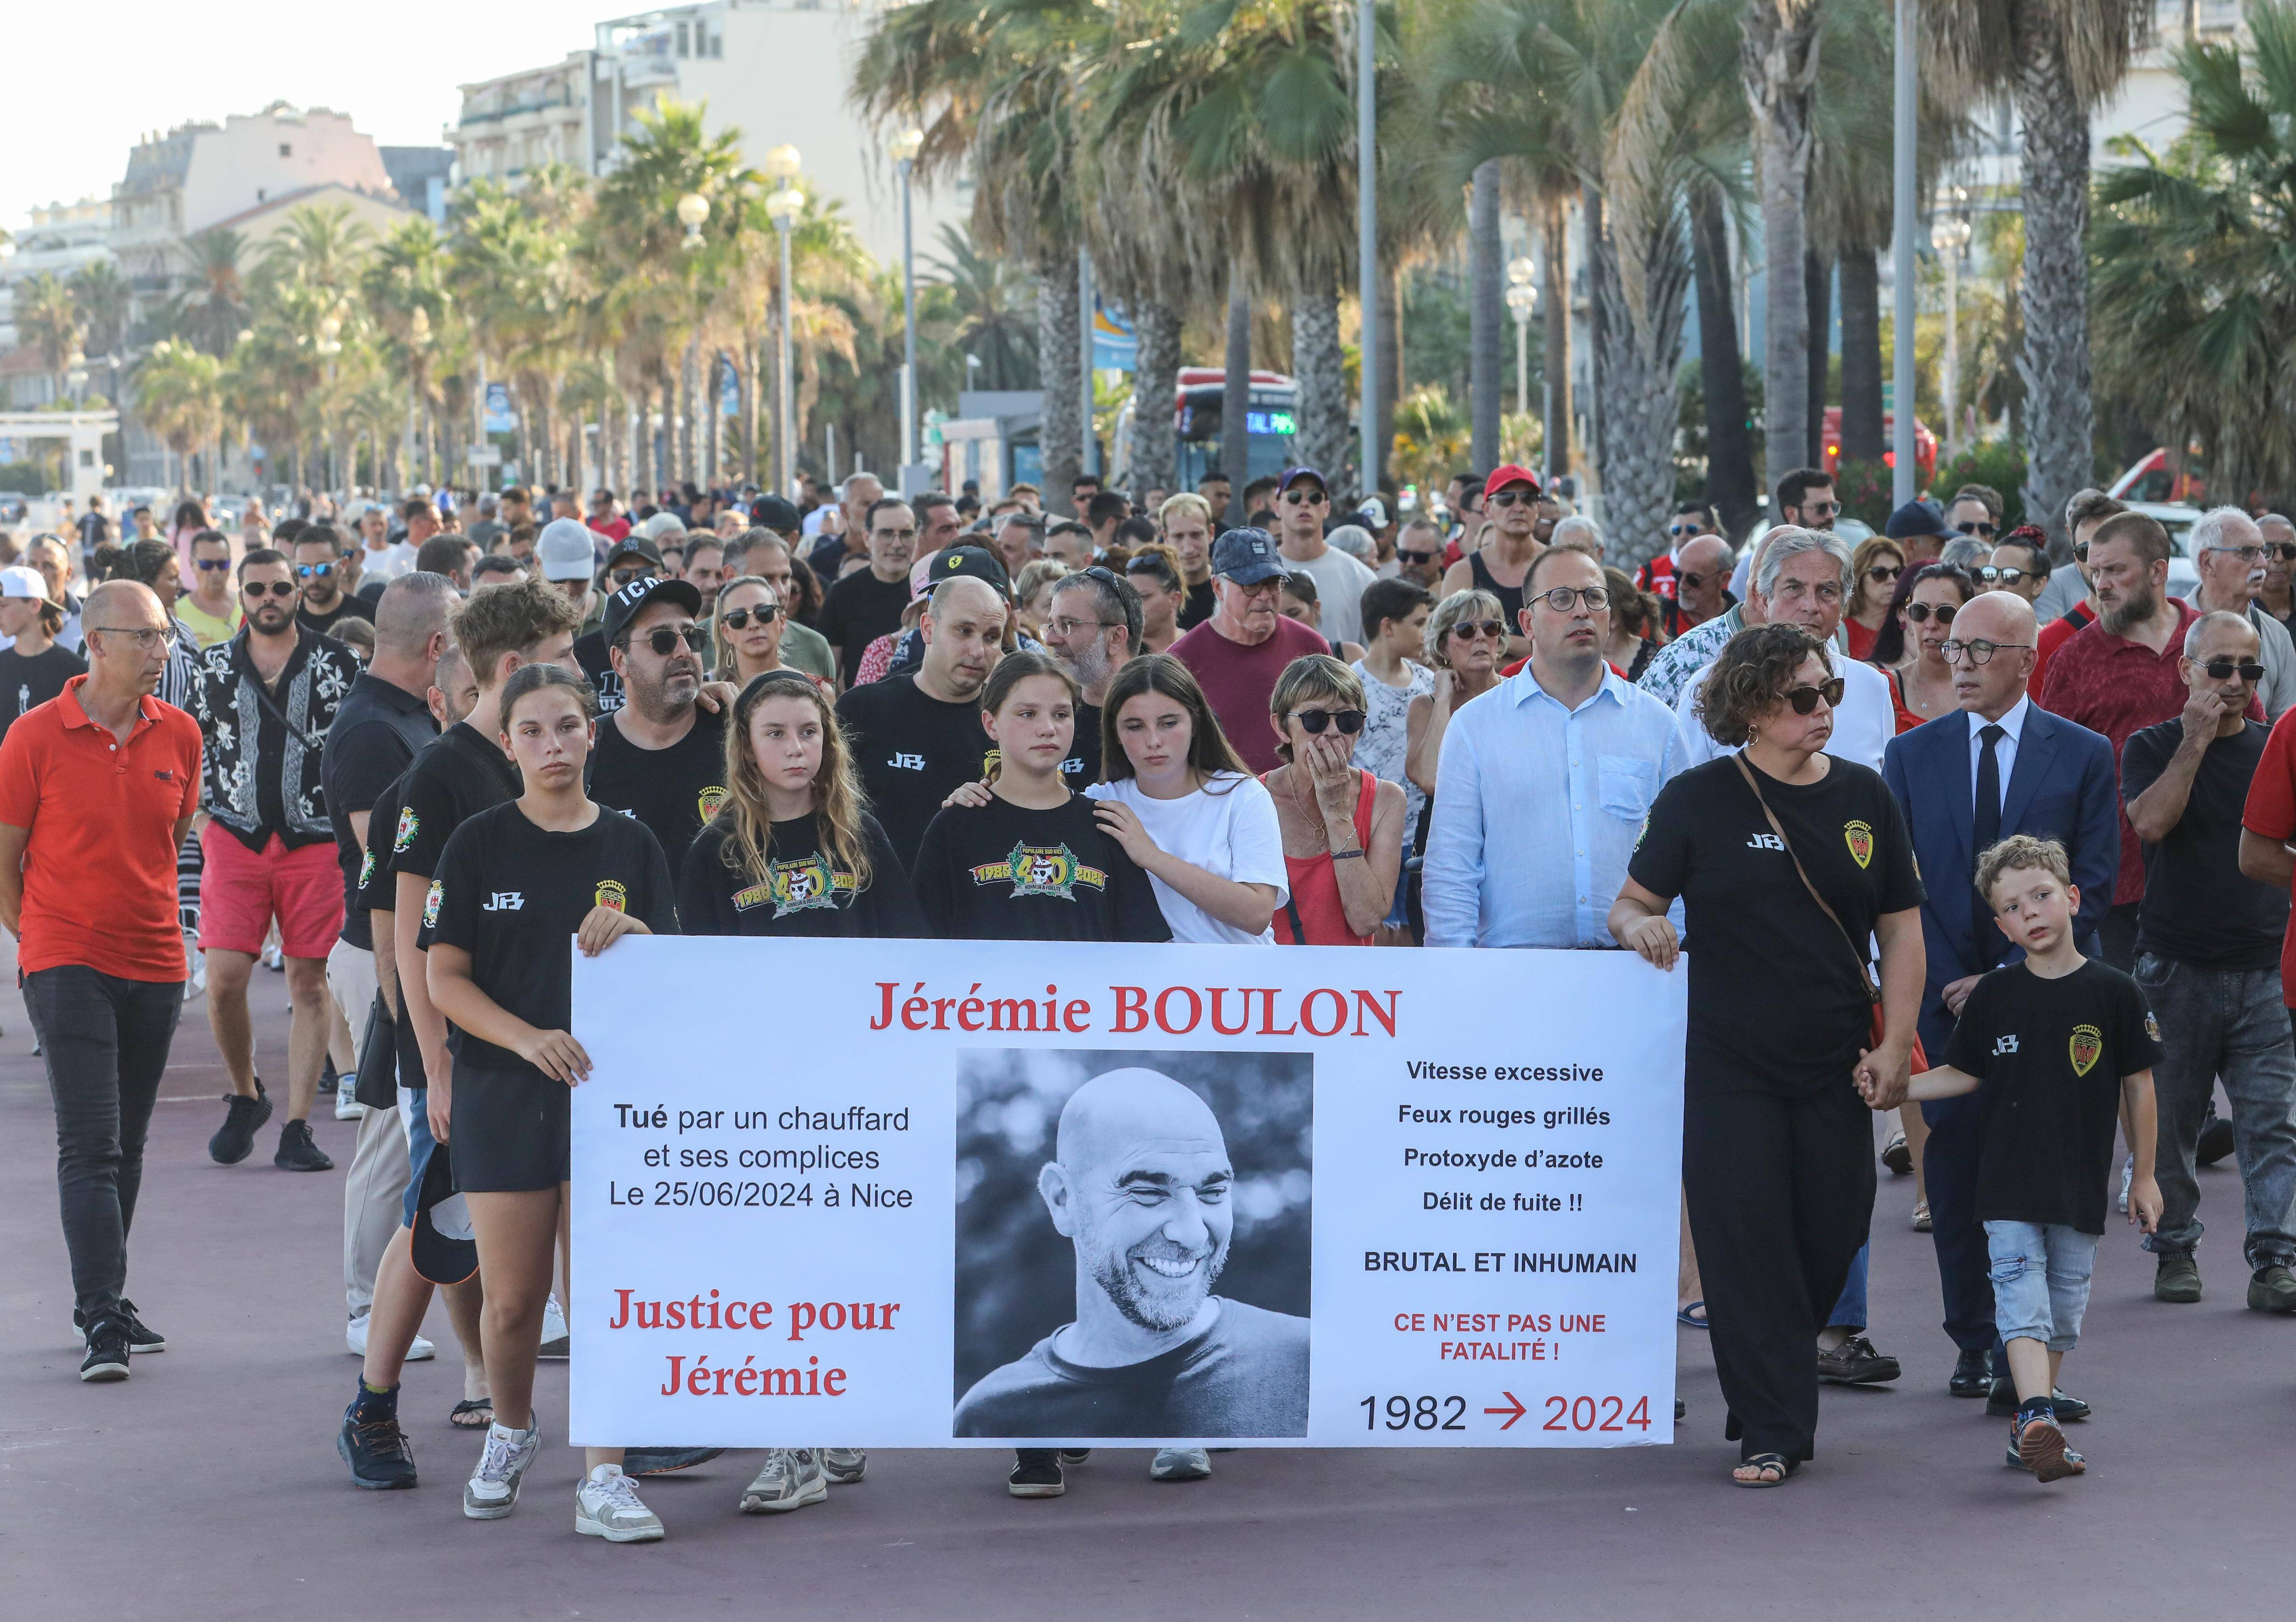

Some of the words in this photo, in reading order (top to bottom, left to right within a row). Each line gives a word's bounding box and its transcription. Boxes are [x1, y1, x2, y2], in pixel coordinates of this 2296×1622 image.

[887, 752, 926, 771] JB
[1746, 833, 1785, 852] JB
[979, 865, 1012, 881] 1985
[483, 892, 525, 911] JB
[601, 891, 622, 899] OGCN
[870, 982, 1090, 1032] Jérémie
[1109, 987, 1402, 1037] BOULON
[2076, 1036, 2098, 1045] OGCN
[1407, 1061, 1486, 1079] Vitesse
[1495, 1064, 1603, 1081] excessive
[614, 1104, 667, 1128] Tué
[680, 1111, 724, 1134] par
[735, 1112, 766, 1128] un
[779, 1106, 908, 1130] chauffard
[1400, 1105, 1451, 1122] Feux
[1460, 1110, 1535, 1128] rouges
[1544, 1107, 1610, 1128] grillés
[645, 1145, 670, 1167] et
[681, 1150, 728, 1167] ses
[740, 1145, 879, 1174] complices
[1405, 1149, 1516, 1171] Protoxyde
[1525, 1150, 1603, 1168] d’azote
[611, 1181, 643, 1205] Le
[655, 1182, 813, 1206] 25/06/2024
[825, 1184, 839, 1207] à
[852, 1184, 912, 1207] Nice
[1424, 1192, 1472, 1210] Délit
[1480, 1193, 1505, 1210] de
[1514, 1193, 1561, 1211] fuite
[1570, 1194, 1582, 1211] !!
[1365, 1252, 1465, 1271] BRUTAL
[1475, 1253, 1505, 1272] ET
[1514, 1253, 1636, 1273] INHUMAIN
[610, 1289, 772, 1329] Justice
[788, 1302, 900, 1340] pour
[1395, 1313, 1424, 1331] CE
[1434, 1314, 1500, 1331] N’EST
[1508, 1314, 1551, 1332] PAS
[1560, 1315, 1605, 1332] UNE
[1441, 1338, 1545, 1360] FATALITÉ
[1554, 1342, 1559, 1360] !
[662, 1356, 846, 1396] Jérémie
[1361, 1396, 1466, 1430] 1982
[1543, 1396, 1651, 1431] 2024
